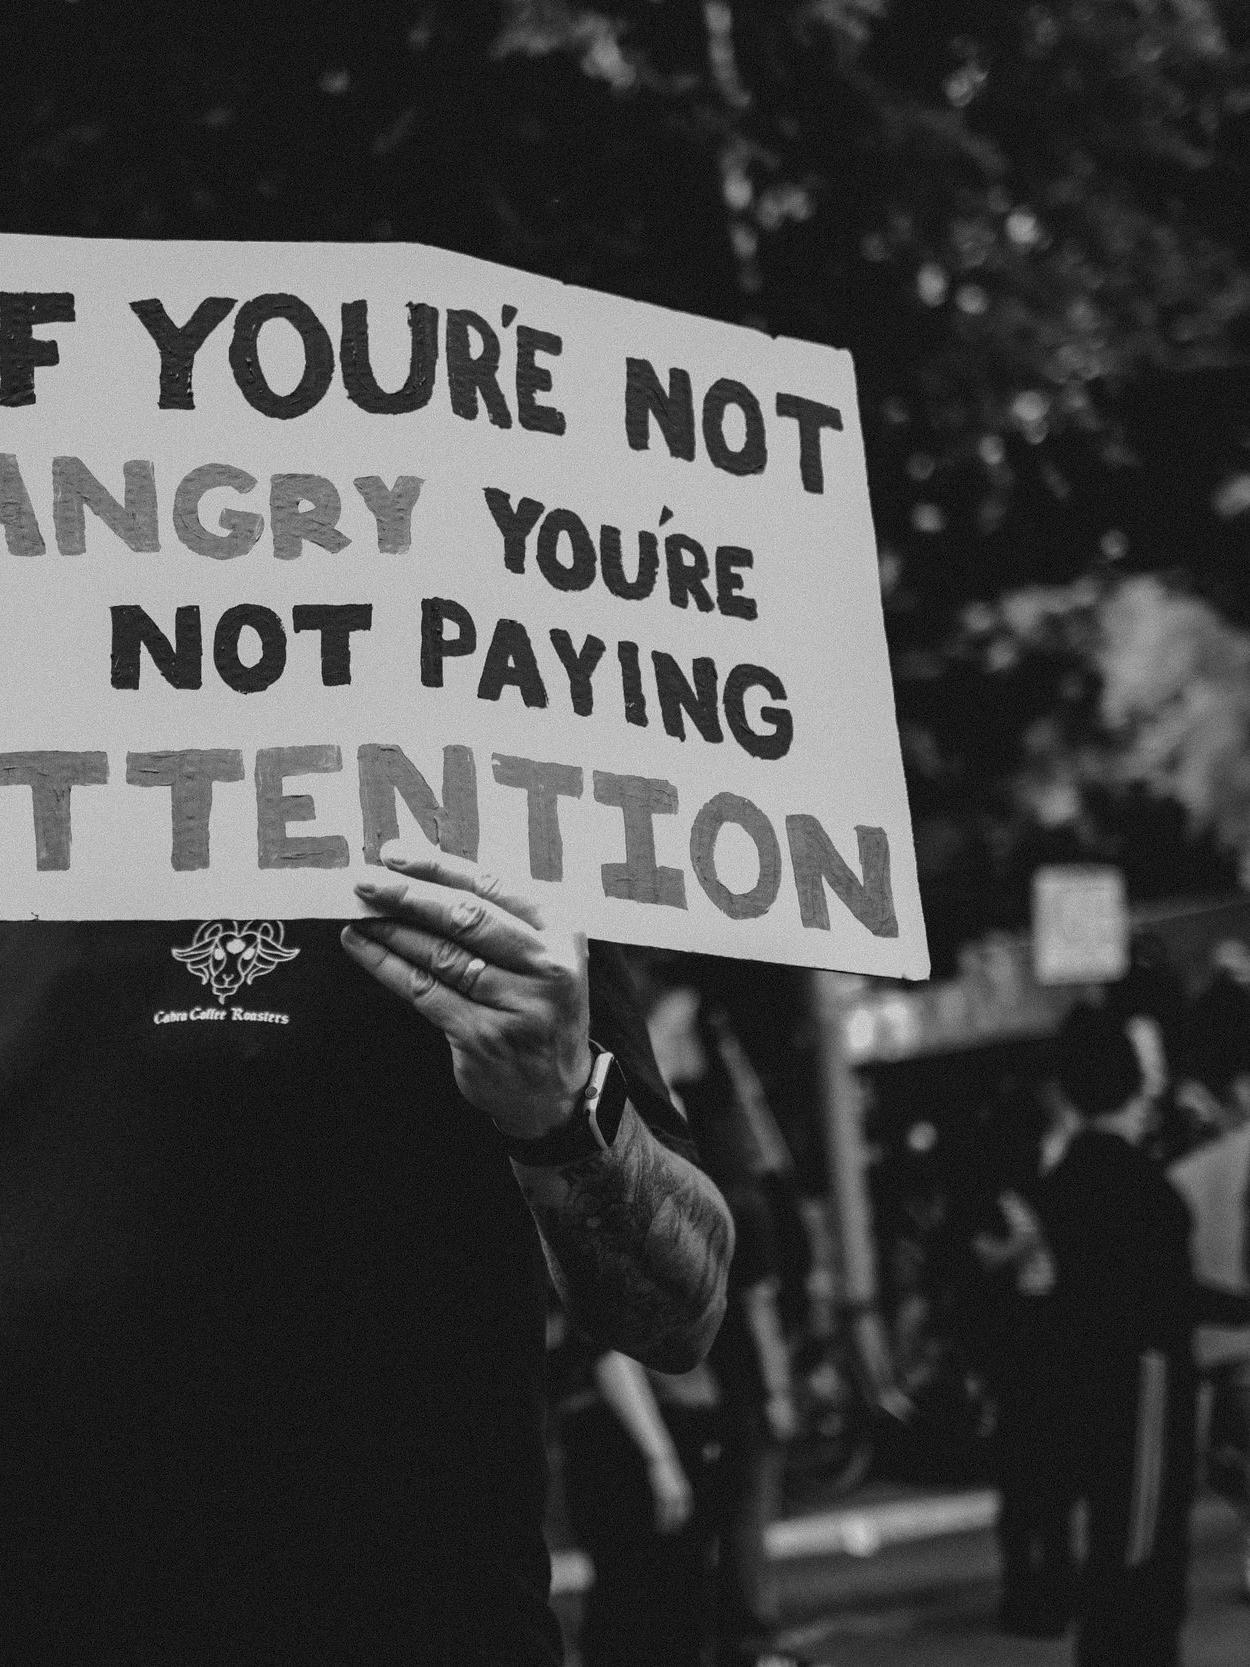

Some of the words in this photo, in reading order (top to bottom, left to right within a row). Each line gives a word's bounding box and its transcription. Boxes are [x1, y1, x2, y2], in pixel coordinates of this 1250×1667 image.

[625, 357, 844, 494] NOT
[483, 487, 758, 621] YOU'RE
[109, 603, 373, 695] NOT
[420, 596, 794, 761] PAYING
[231, 1006, 289, 1025] Roasters
